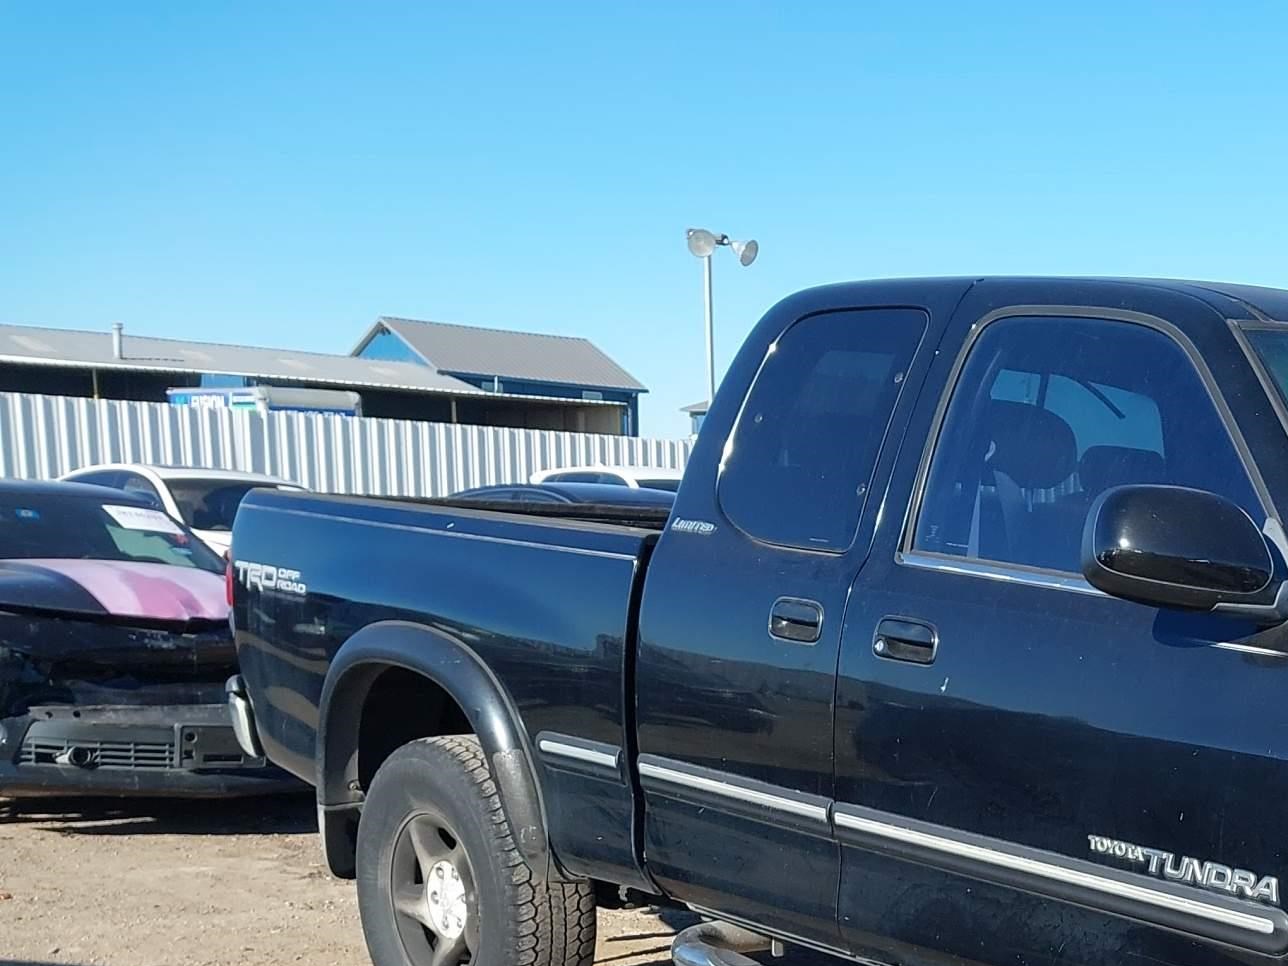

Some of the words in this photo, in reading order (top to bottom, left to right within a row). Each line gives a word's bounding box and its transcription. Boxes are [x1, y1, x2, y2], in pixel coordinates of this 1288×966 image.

[235, 560, 277, 592] TRD
[278, 568, 301, 580] OFF
[277, 580, 306, 593] ROAD
[1088, 834, 1145, 861] TOYOTA
[1144, 849, 1280, 904] TUNDRA
